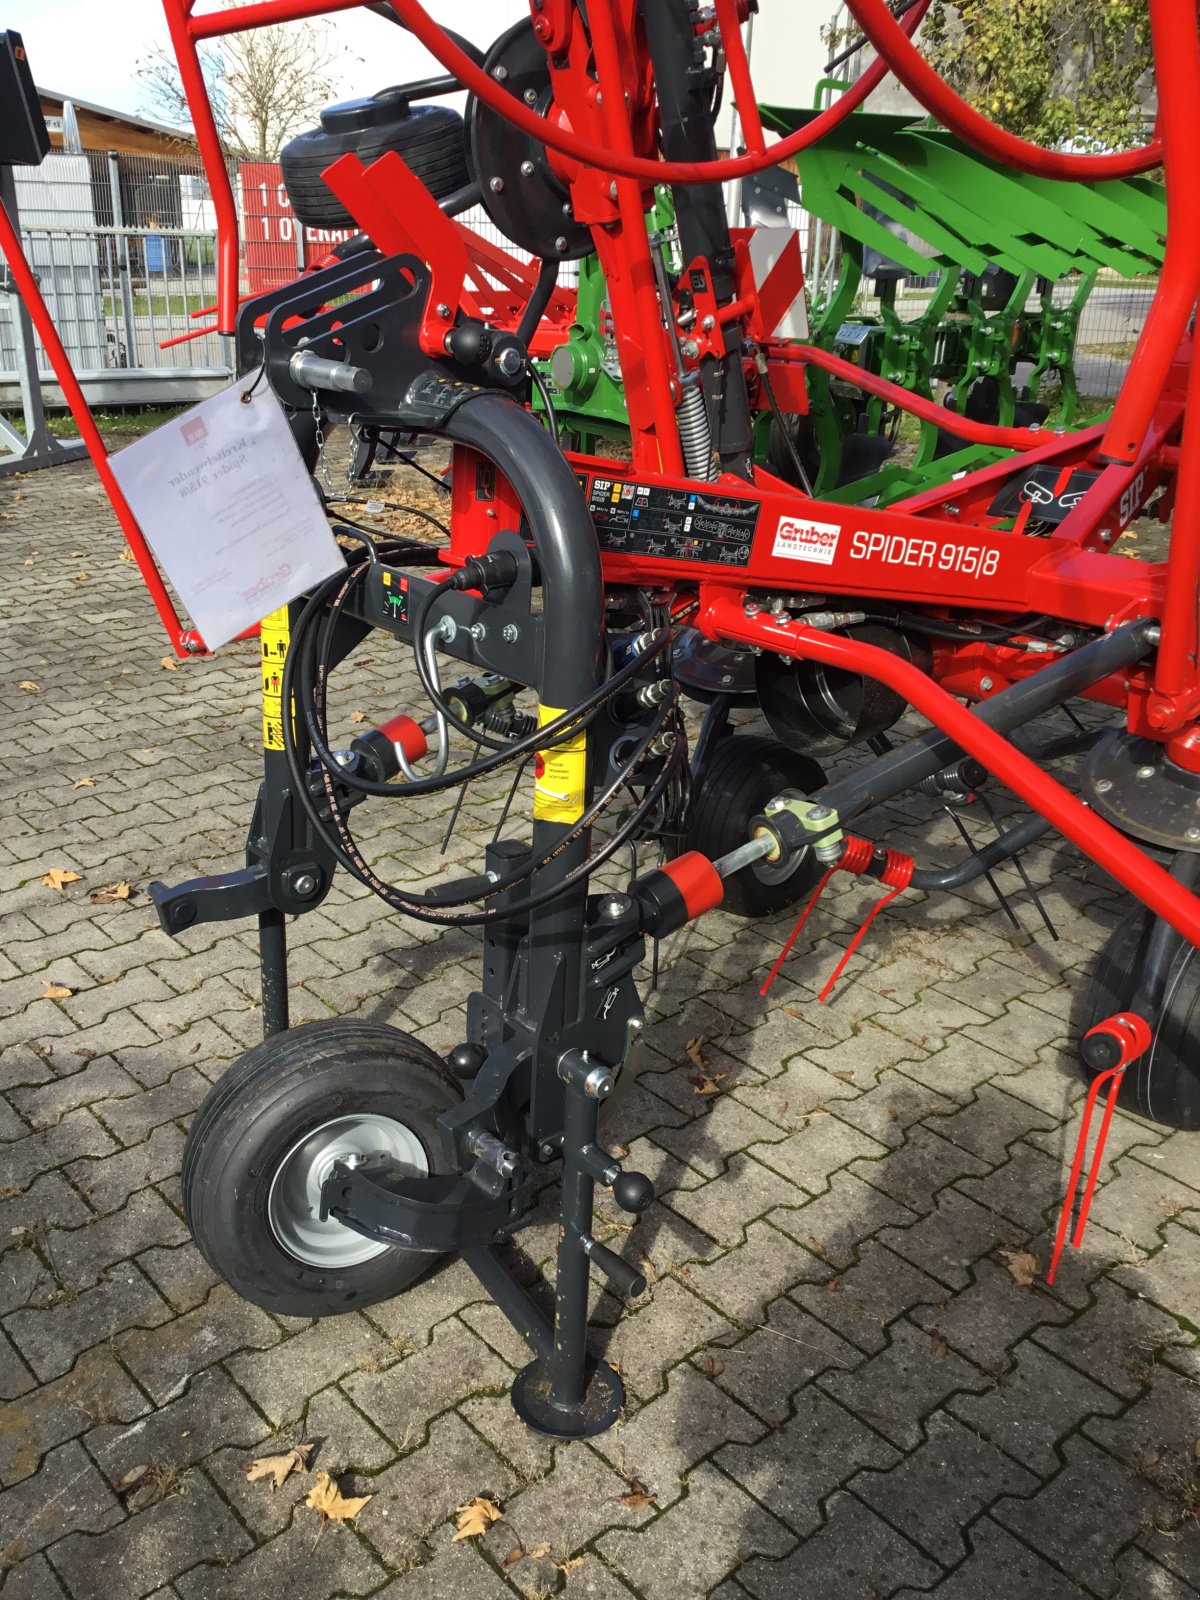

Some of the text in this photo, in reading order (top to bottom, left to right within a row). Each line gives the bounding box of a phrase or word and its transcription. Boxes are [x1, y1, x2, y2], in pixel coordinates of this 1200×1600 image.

[260, 183, 268, 208] 1
[262, 217, 270, 240] 1
[594, 480, 611, 491] SIP
[1119, 472, 1144, 528] SIP
[780, 521, 836, 547] Gruber
[849, 531, 937, 568] SPIDER
